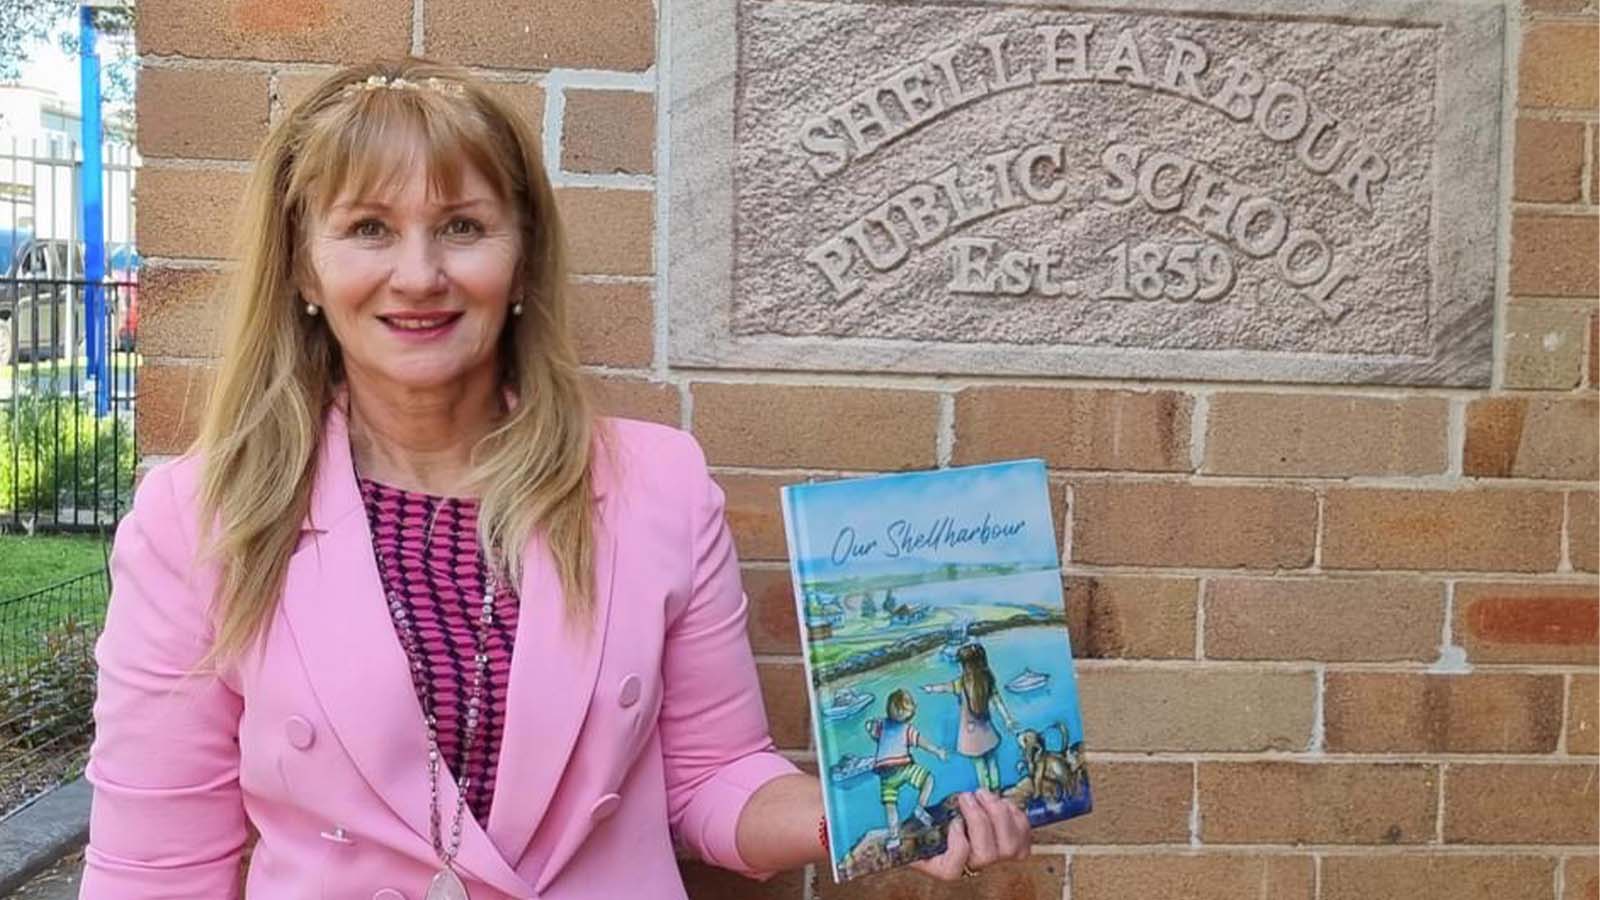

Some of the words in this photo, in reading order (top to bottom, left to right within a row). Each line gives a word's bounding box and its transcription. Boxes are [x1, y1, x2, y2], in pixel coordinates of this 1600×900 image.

[801, 24, 1390, 211] SHELLHARBOUR
[806, 143, 1067, 300] PUBLIC
[1099, 143, 1356, 322] SCHOOL
[948, 237, 1078, 297] Est.
[1103, 240, 1236, 301] 1859
[831, 526, 877, 566] Our
[884, 512, 1026, 558] Shellharbour
